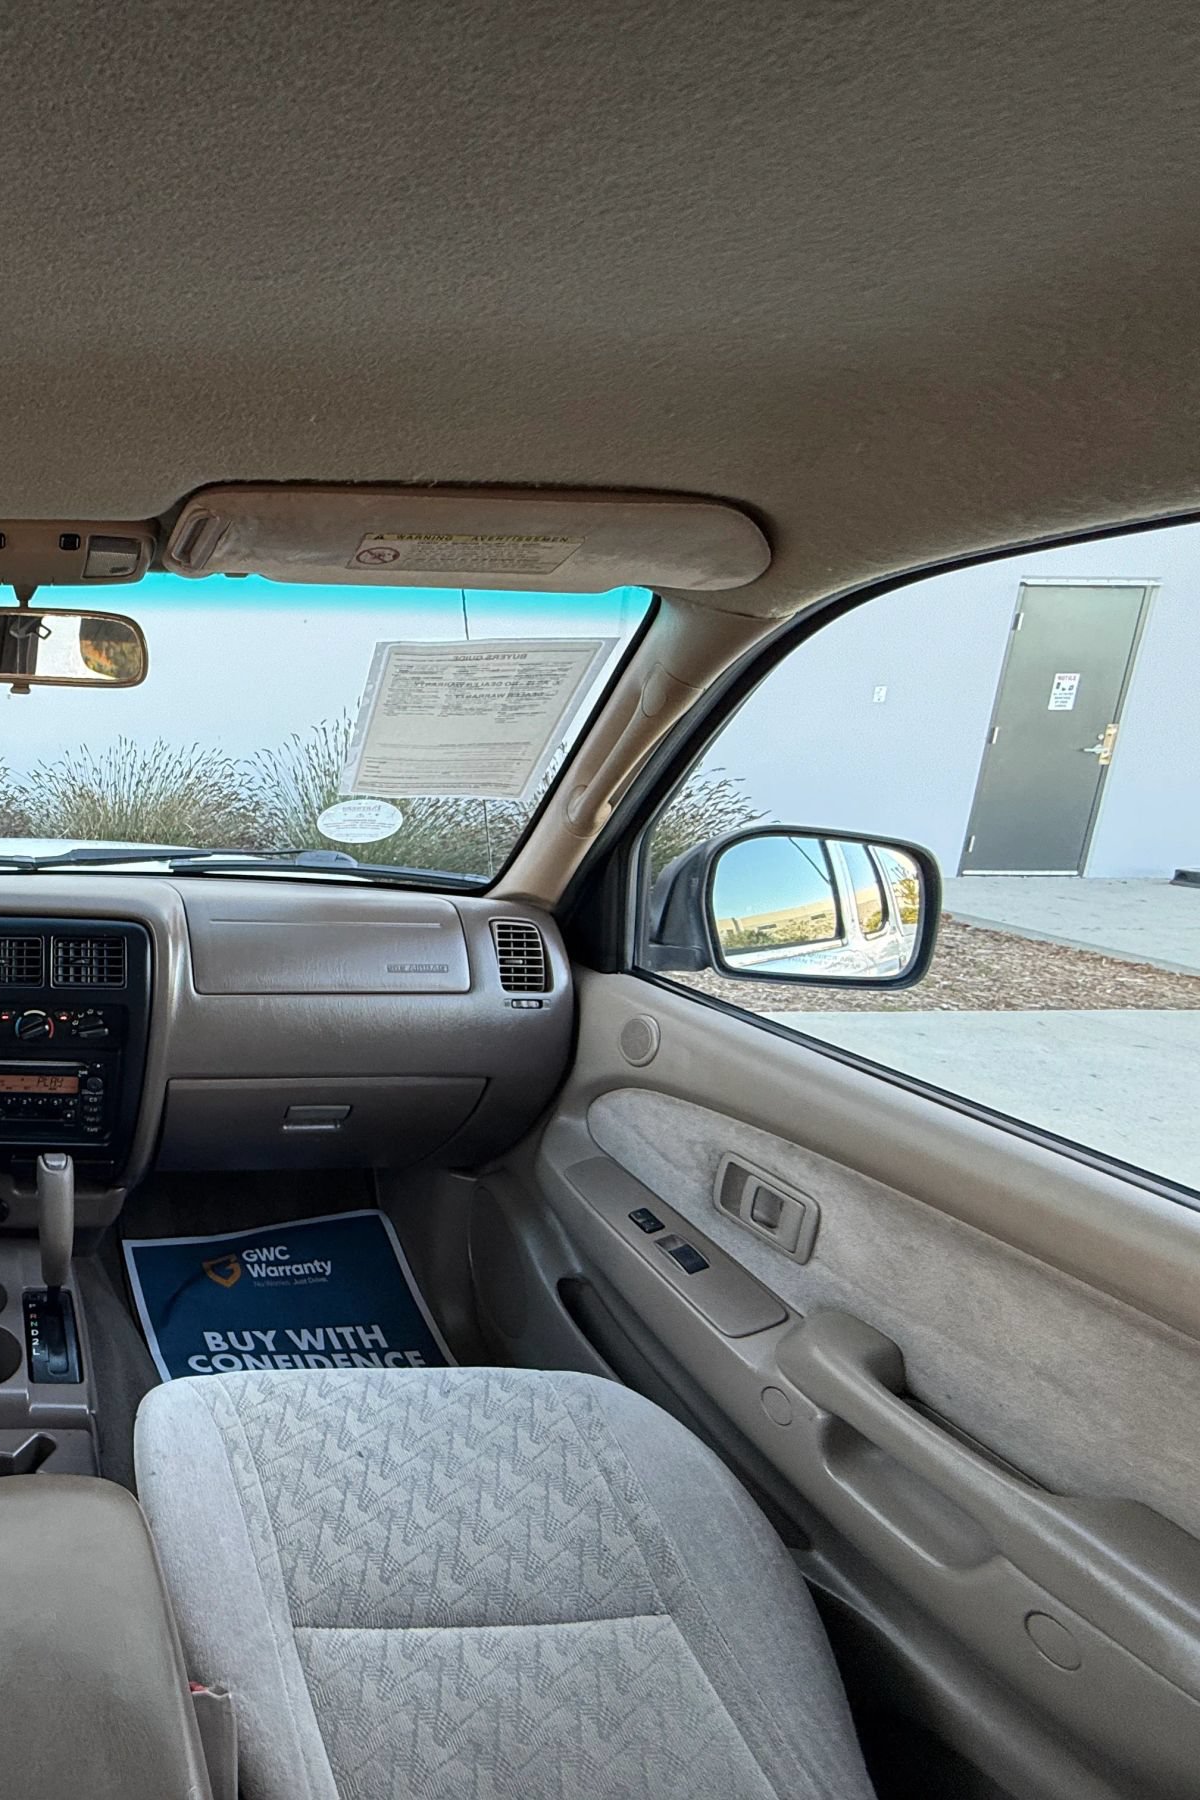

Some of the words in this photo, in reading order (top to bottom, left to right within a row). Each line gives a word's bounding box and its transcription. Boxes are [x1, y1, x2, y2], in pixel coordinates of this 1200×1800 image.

[36, 1076, 64, 1088] PLAY
[242, 1245, 290, 1262] GWC
[246, 1259, 332, 1278] Warranty
[32, 1338, 40, 1346] 2
[203, 1330, 277, 1352] BUY
[285, 1325, 389, 1351] WITH
[32, 1348, 41, 1356] L
